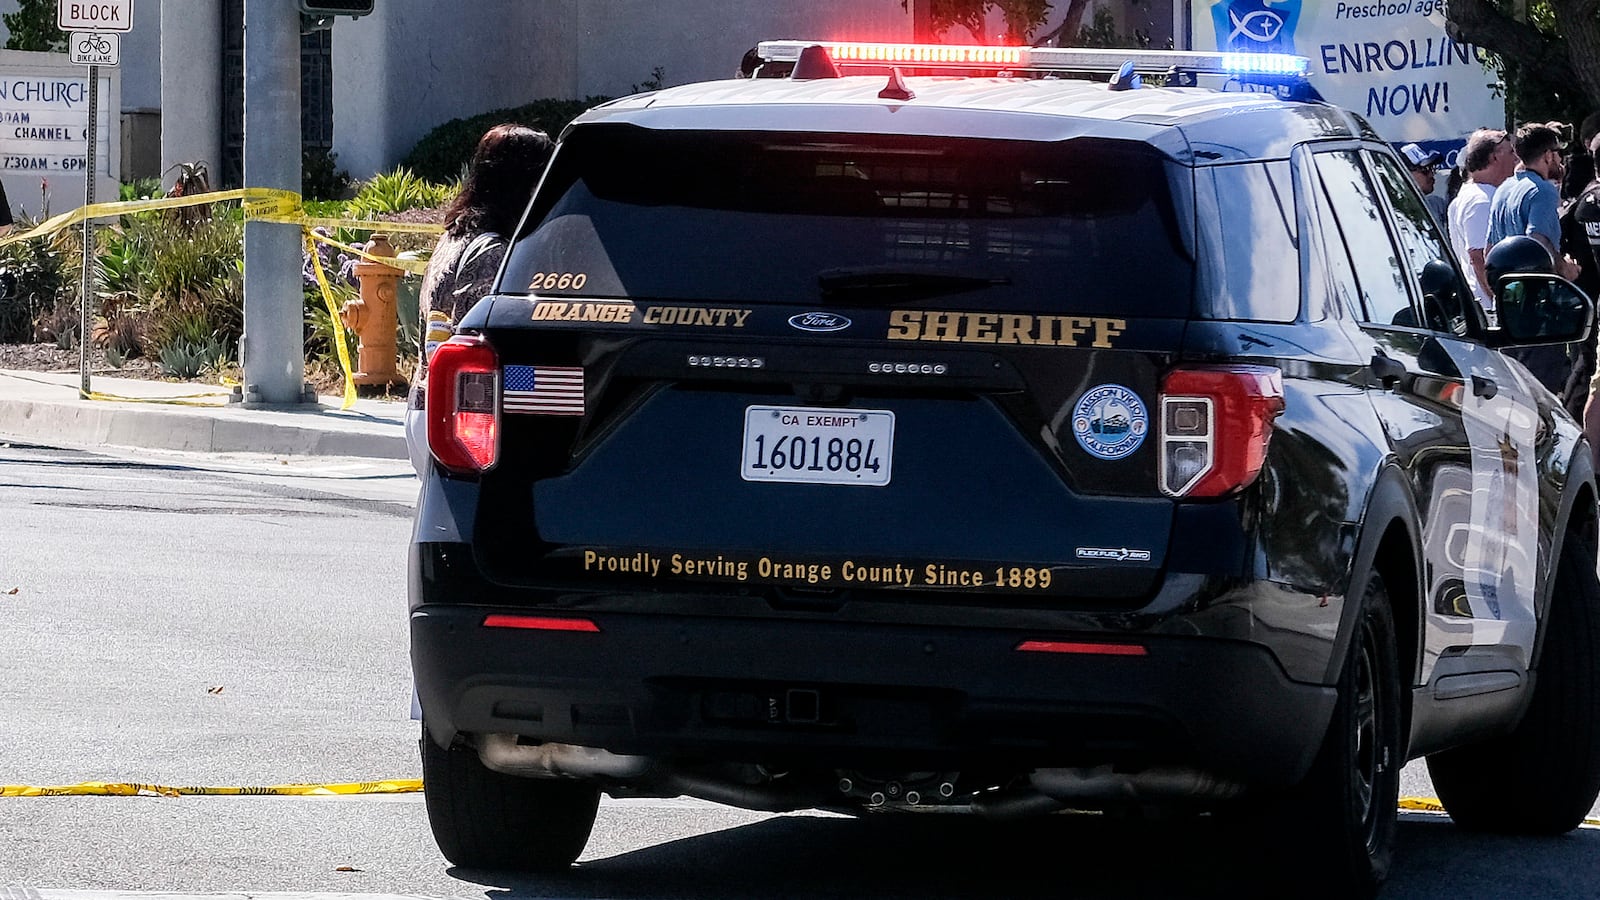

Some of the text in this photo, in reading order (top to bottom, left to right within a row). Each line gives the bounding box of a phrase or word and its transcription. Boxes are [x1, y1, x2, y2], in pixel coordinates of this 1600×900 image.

[71, 4, 120, 21] BLOCK
[1336, 0, 1412, 19] Preschool
[77, 54, 112, 63] BIKE LANE
[1366, 82, 1450, 117] NOW!
[15, 127, 71, 140] CHANNEL
[3, 157, 48, 169] 7:30AM
[528, 272, 587, 291] 2660
[531, 302, 753, 328] ORANGE COUNTY
[887, 310, 1127, 348] SHERIFF
[1075, 390, 1144, 417] MISSION VIEJO
[782, 415, 859, 428] CA EXEMPT
[1084, 433, 1137, 453] CALIFORNIA
[752, 434, 880, 473] 1601884
[584, 550, 1052, 589] Proudly Serving Orange County Since 1889
